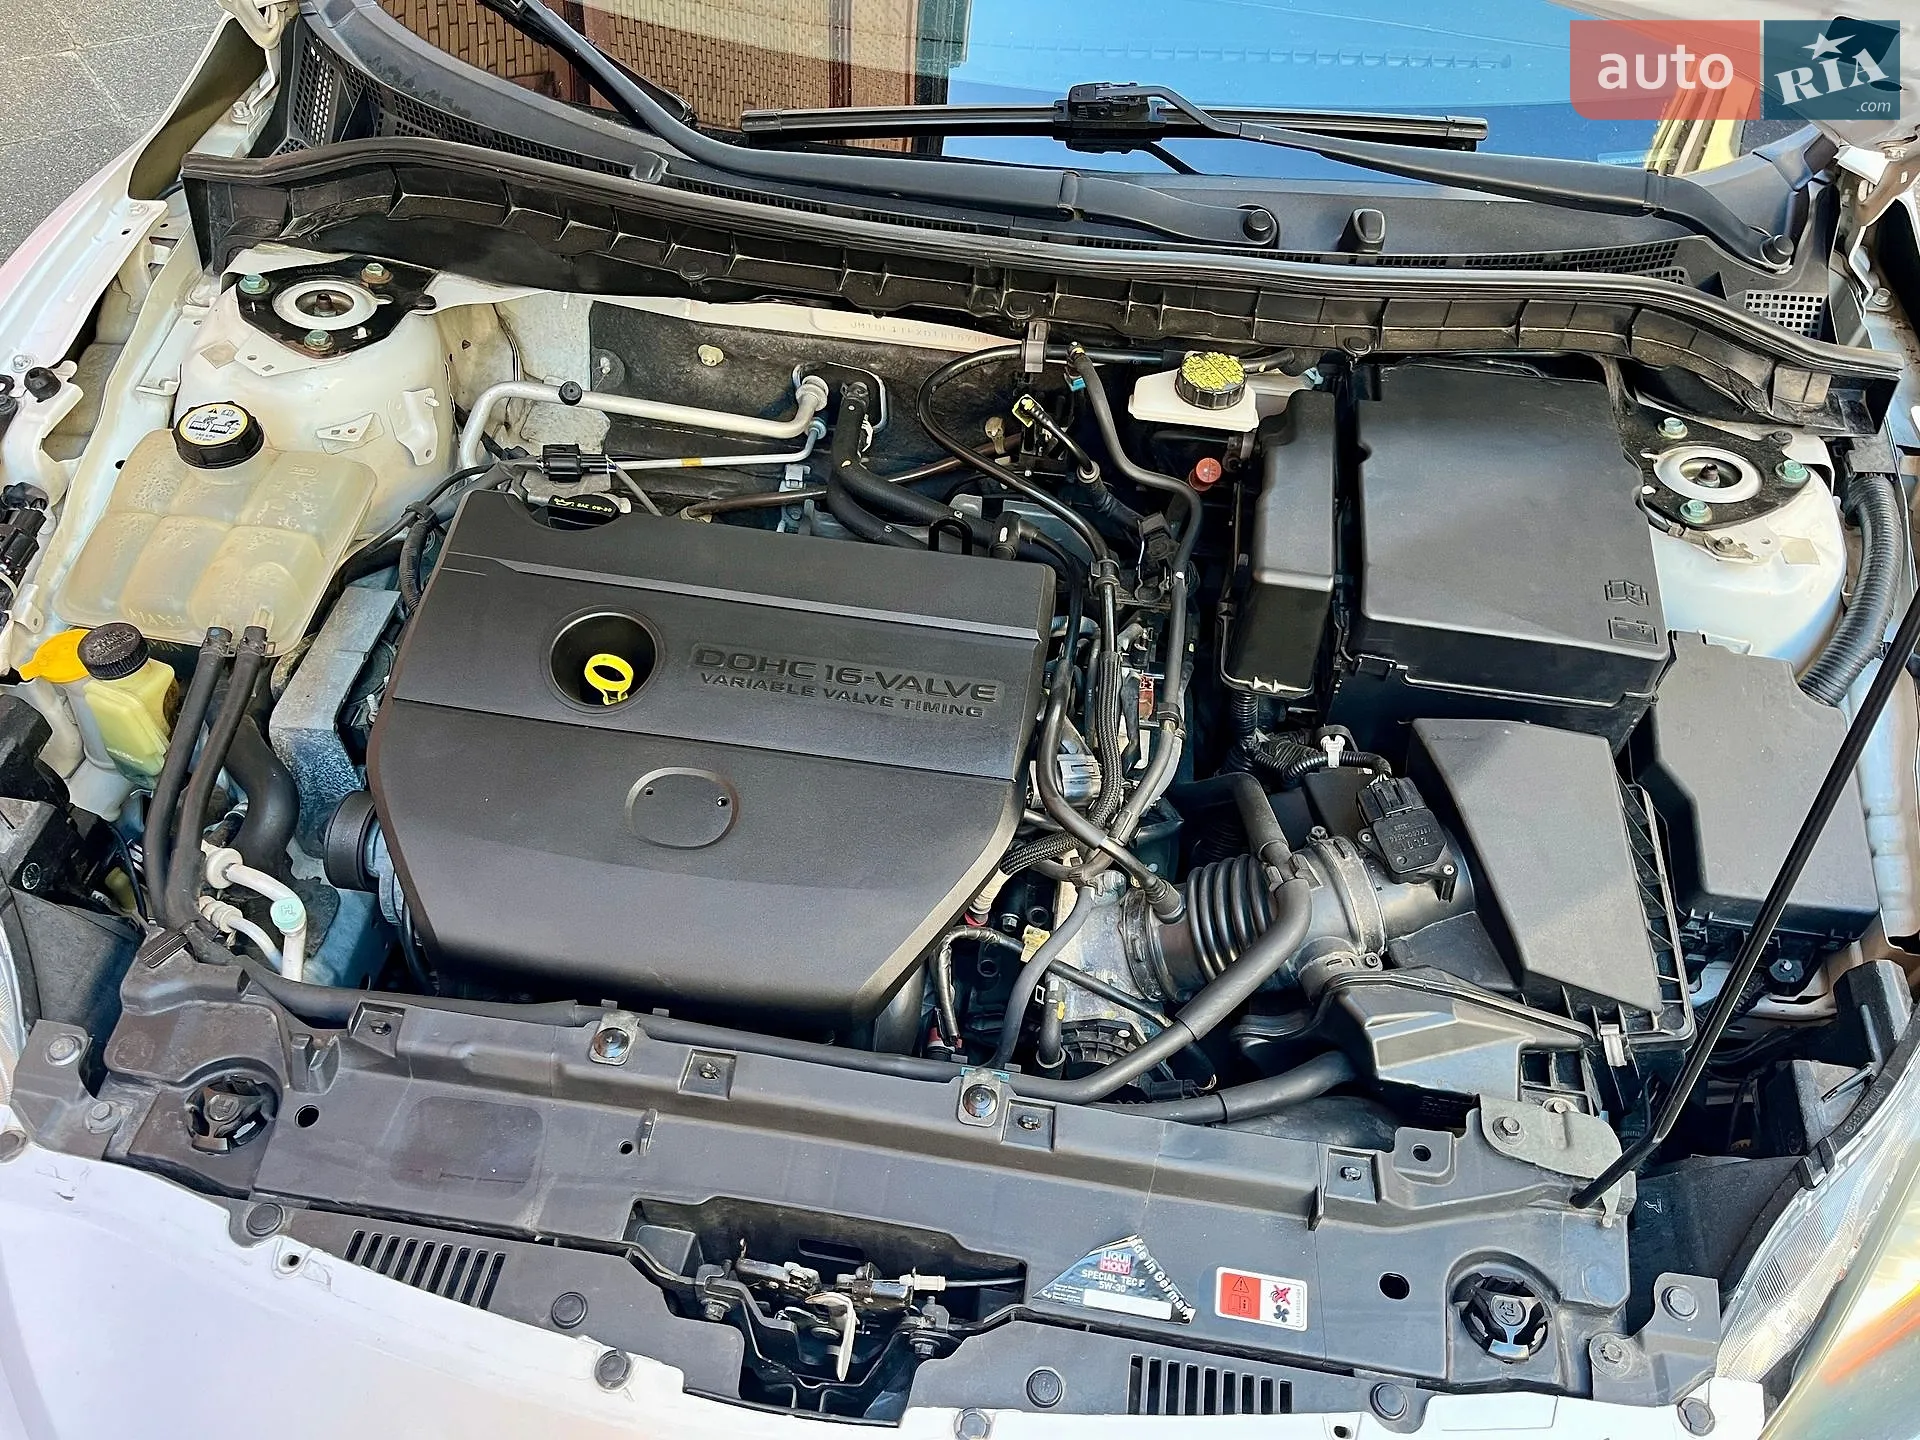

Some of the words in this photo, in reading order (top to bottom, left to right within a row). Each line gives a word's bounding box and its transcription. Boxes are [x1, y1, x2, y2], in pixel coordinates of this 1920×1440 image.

[695, 648, 817, 680] DOHC
[824, 663, 998, 702] 16-VALVE
[700, 672, 816, 698] VARIABLE
[823, 687, 897, 708] VALVE
[900, 698, 985, 718] TIMING
[1103, 1250, 1131, 1264] LIQUI
[1102, 1260, 1131, 1273] MOLY
[1081, 1269, 1117, 1283] SPECIAL
[1121, 1275, 1138, 1286] TEC
[1098, 1281, 1127, 1293] 5W-30
